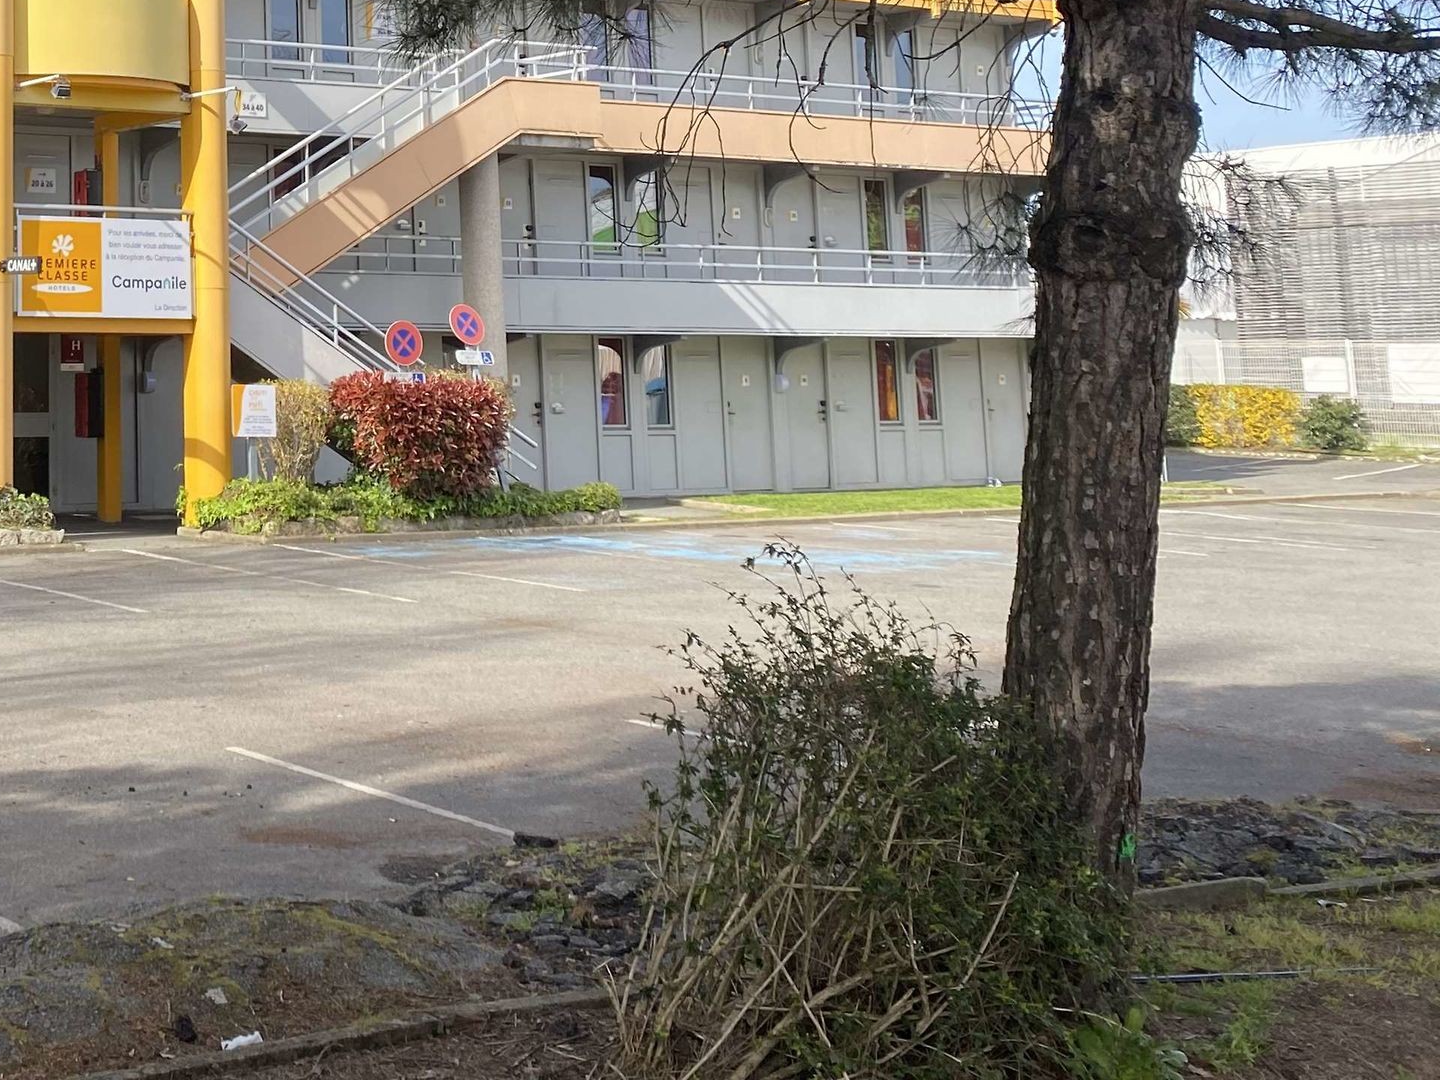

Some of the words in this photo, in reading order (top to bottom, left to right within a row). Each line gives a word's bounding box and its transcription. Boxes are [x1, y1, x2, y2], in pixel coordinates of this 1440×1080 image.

[256, 104, 264, 112] 40
[7, 258, 37, 271] CANAL+
[45, 258, 97, 270] EMIERE
[37, 270, 89, 281] CLASSE
[48, 284, 77, 292] HOTELS
[111, 275, 187, 293] Campanile
[71, 339, 81, 351] H
